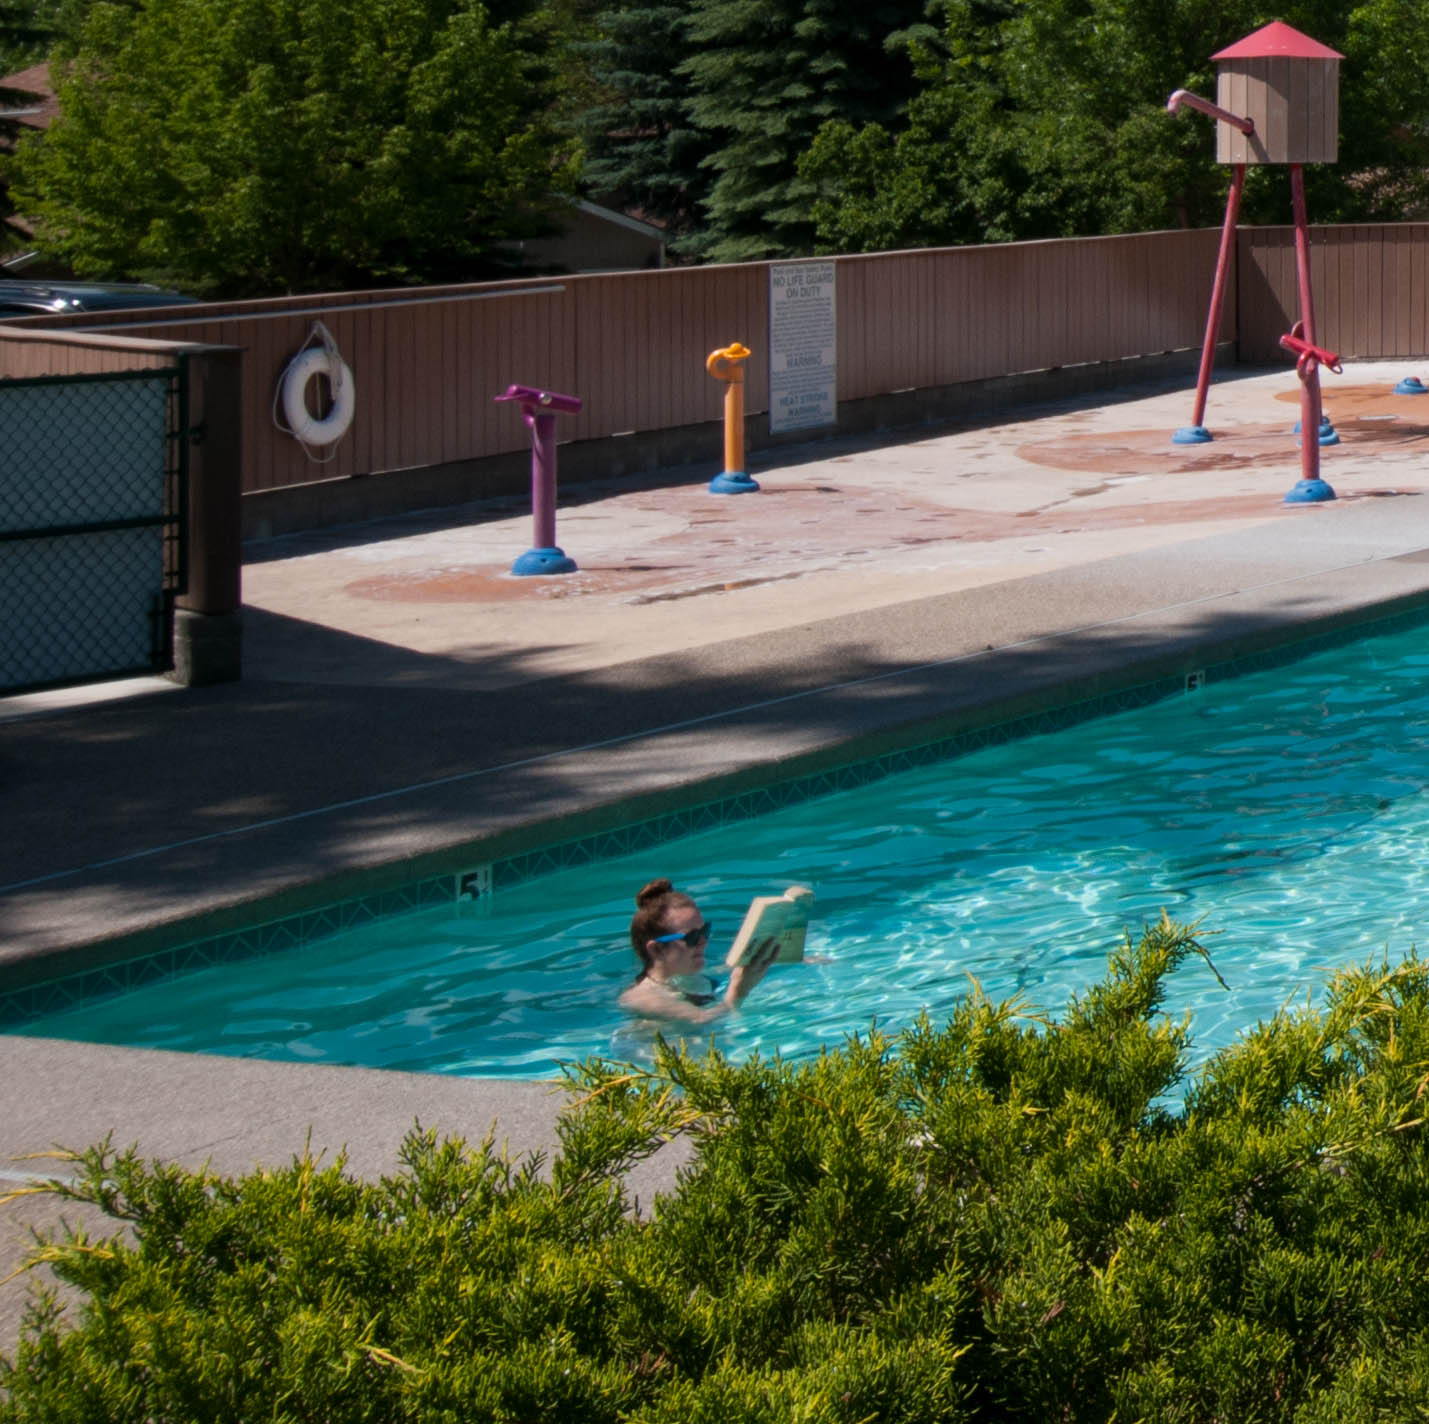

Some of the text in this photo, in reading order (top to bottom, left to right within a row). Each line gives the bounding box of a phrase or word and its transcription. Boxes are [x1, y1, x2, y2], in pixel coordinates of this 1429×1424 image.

[773, 272, 833, 288] NO LIFE GUARD
[786, 285, 821, 298] ON DUTY
